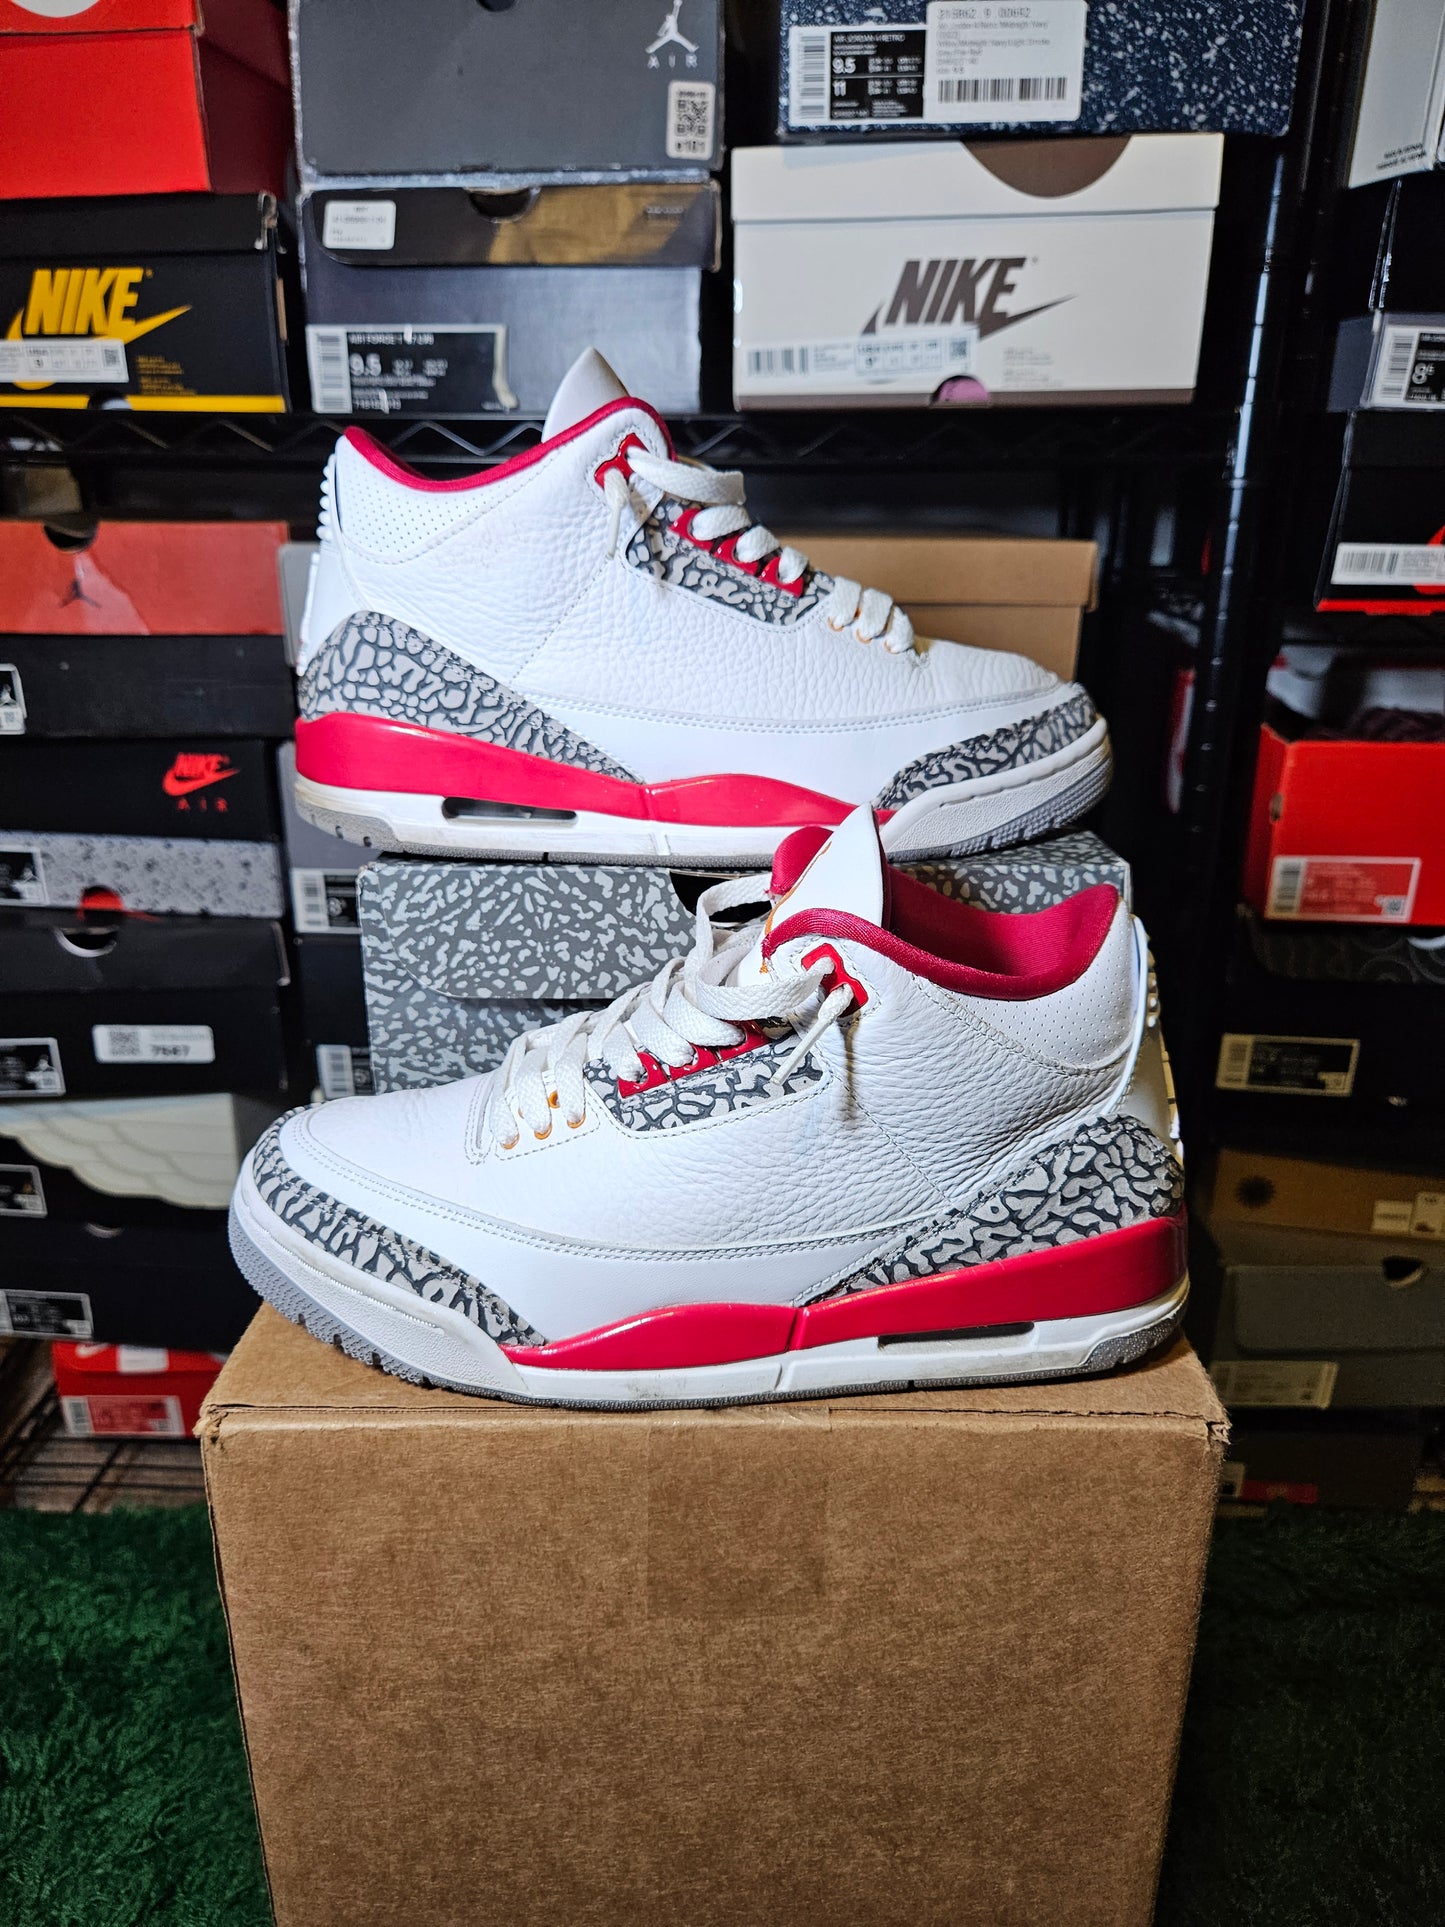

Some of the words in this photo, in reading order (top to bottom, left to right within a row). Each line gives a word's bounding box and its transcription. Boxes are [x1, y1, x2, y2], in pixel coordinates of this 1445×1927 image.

[647, 53, 699, 68] AIR
[832, 57, 856, 74] 9.5
[832, 80, 847, 96] 11
[24, 267, 144, 335] NIKE
[884, 257, 1027, 326] NIKE
[350, 353, 382, 376] 9.5
[174, 752, 224, 778] NIKE
[177, 797, 228, 812] AIR
